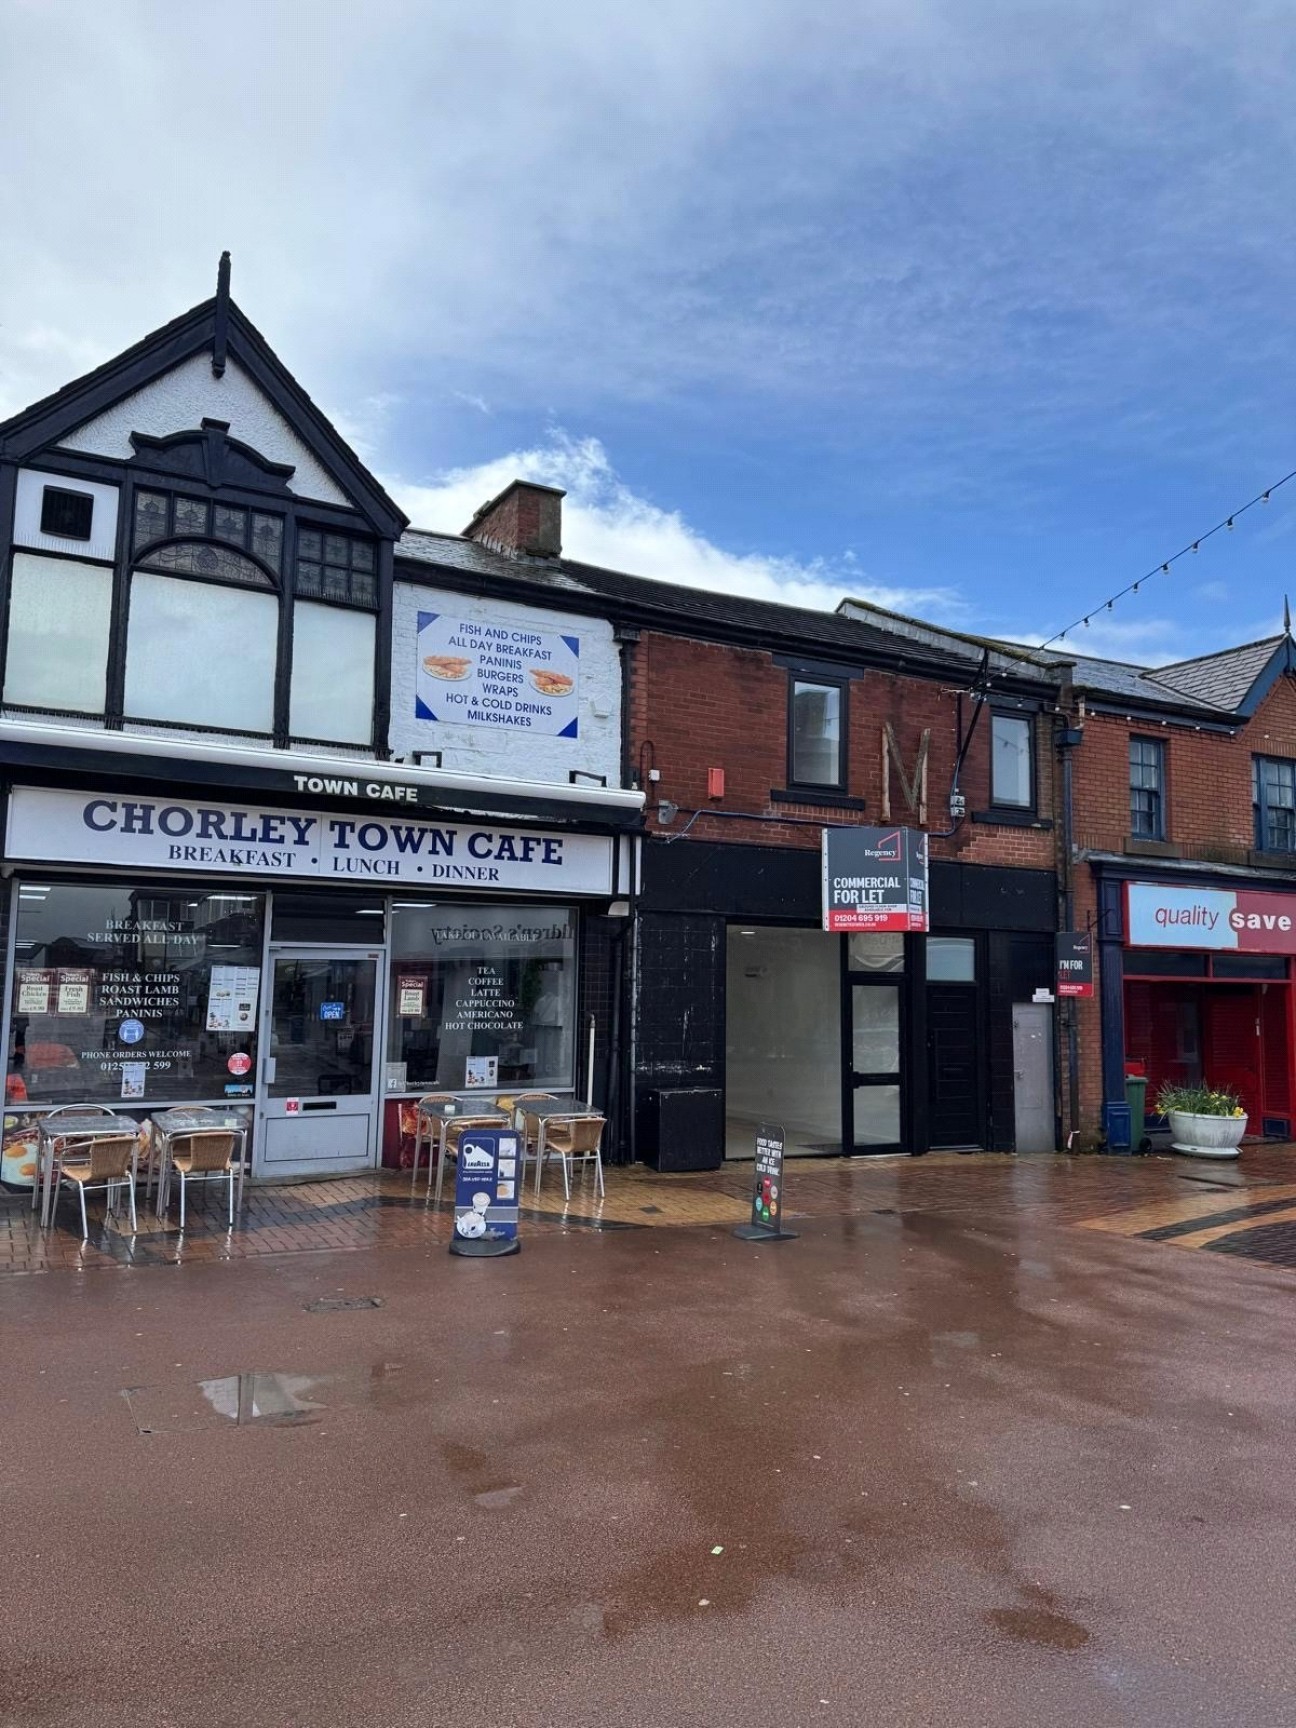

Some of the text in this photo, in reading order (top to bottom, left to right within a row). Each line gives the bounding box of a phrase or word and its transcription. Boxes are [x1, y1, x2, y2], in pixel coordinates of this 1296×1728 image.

[459, 623, 542, 646] FISH AND CHIPS
[448, 636, 552, 661] ALL DAY BREAKFAST
[480, 654, 522, 670] PANINIS
[477, 669, 524, 684] BURGERS
[482, 682, 519, 698] WRAPS
[446, 693, 553, 716] HOT & COLD DRINKS
[467, 709, 532, 727] MILKSHAKES
[293, 775, 418, 802] TOWN CAFE
[82, 799, 564, 865] CHORLEY TOWN CAFE
[864, 849, 898, 859] Regency
[168, 844, 500, 881] BREAKFAST LUNCH DINNER
[833, 877, 901, 888] COMMERCIAL
[833, 890, 885, 904] FOR LET
[834, 914, 858, 923] 01204
[858, 914, 873, 922] 695
[1155, 904, 1220, 931] quality
[1231, 911, 1292, 931] save
[105, 919, 184, 932] BREAKFAST
[87, 933, 199, 945] SERVED ALL DAY
[1070, 960, 1083, 970] FOR
[477, 967, 495, 975] TEA
[21, 975, 50, 983] Special
[60, 974, 88, 983] Special
[102, 973, 180, 983] FISH & CHIPS
[468, 977, 504, 986] COFFEE
[102, 985, 179, 995] ROAST LAMB
[470, 988, 501, 997] LATTE
[99, 996, 180, 1007] SANDWICHES
[455, 999, 515, 1008] CAPPUCCINO
[116, 1008, 163, 1018] PANINIS
[324, 1011, 340, 1019] OPEN
[457, 1011, 514, 1019] AMERICANO
[445, 1021, 524, 1030] HOT CHOCOLATE
[81, 1050, 192, 1060] PHONE ORDERS WELCOME
[153, 1061, 171, 1070] 599
